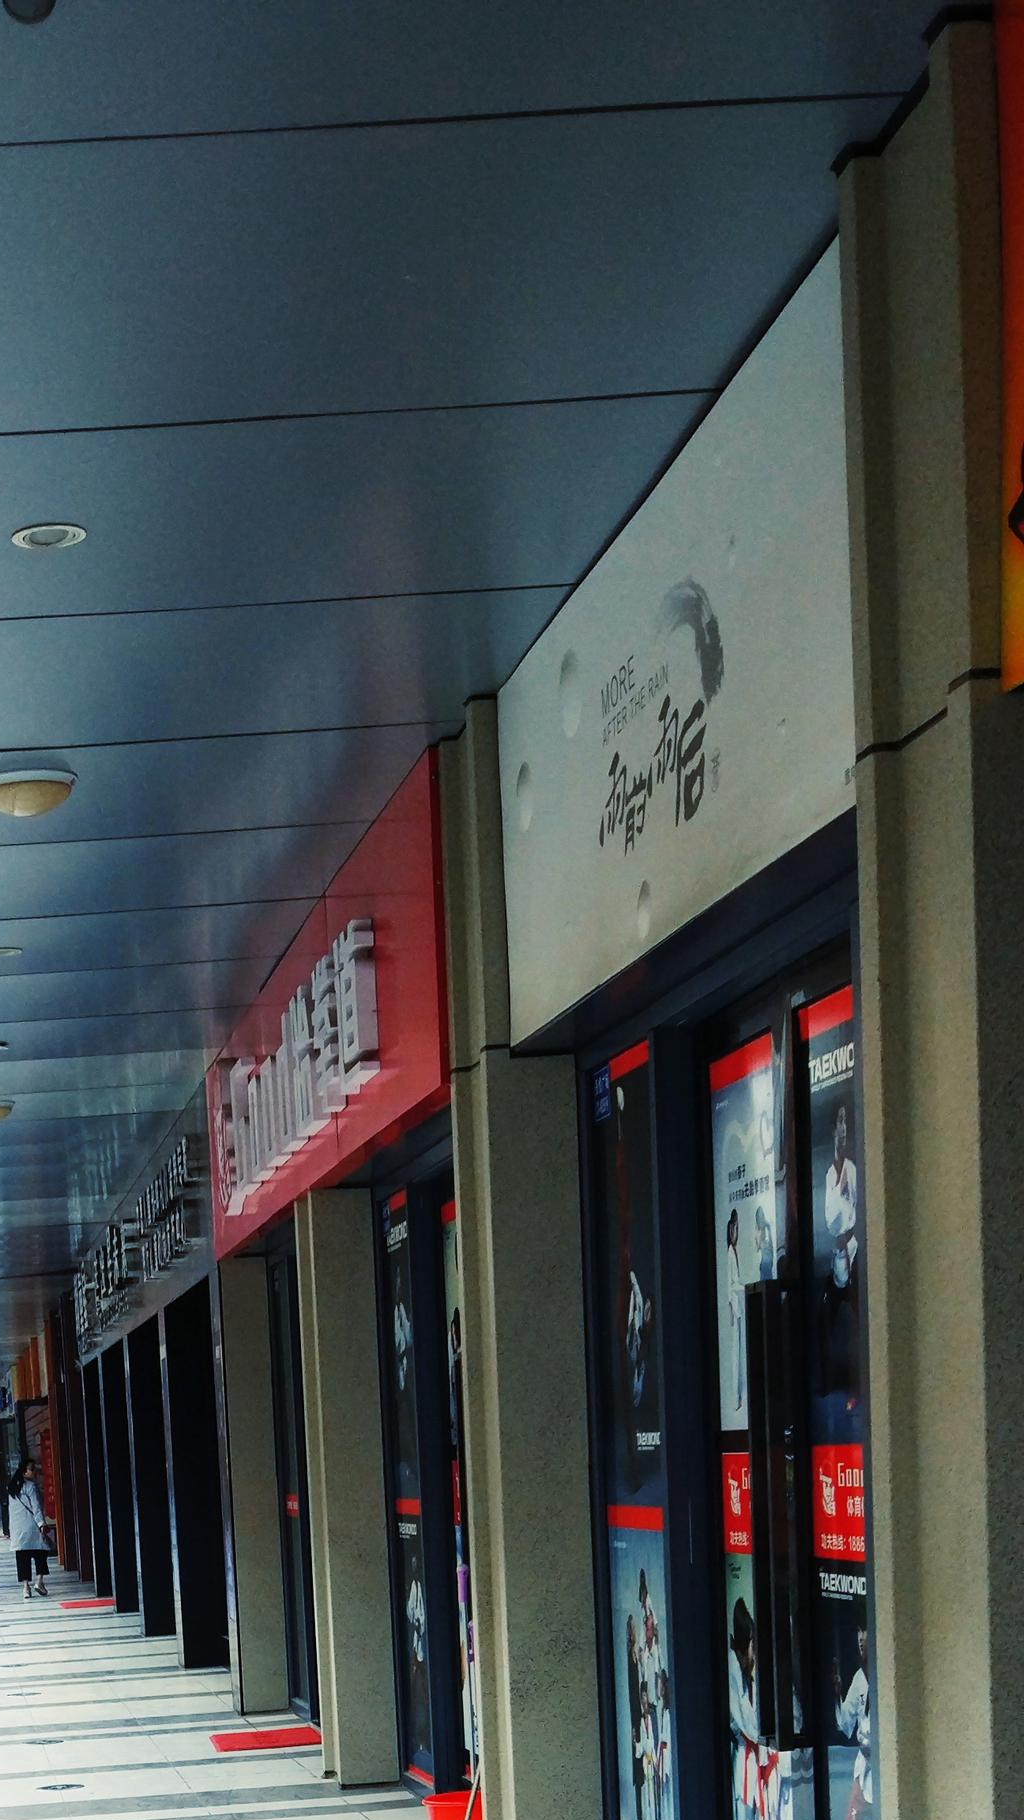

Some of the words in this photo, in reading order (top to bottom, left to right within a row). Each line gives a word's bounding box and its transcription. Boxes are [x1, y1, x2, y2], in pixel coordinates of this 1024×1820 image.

[600, 655, 636, 718] MORE
[601, 706, 629, 747] AFTER
[629, 685, 647, 718] THE
[648, 663, 670, 701] RAIN
